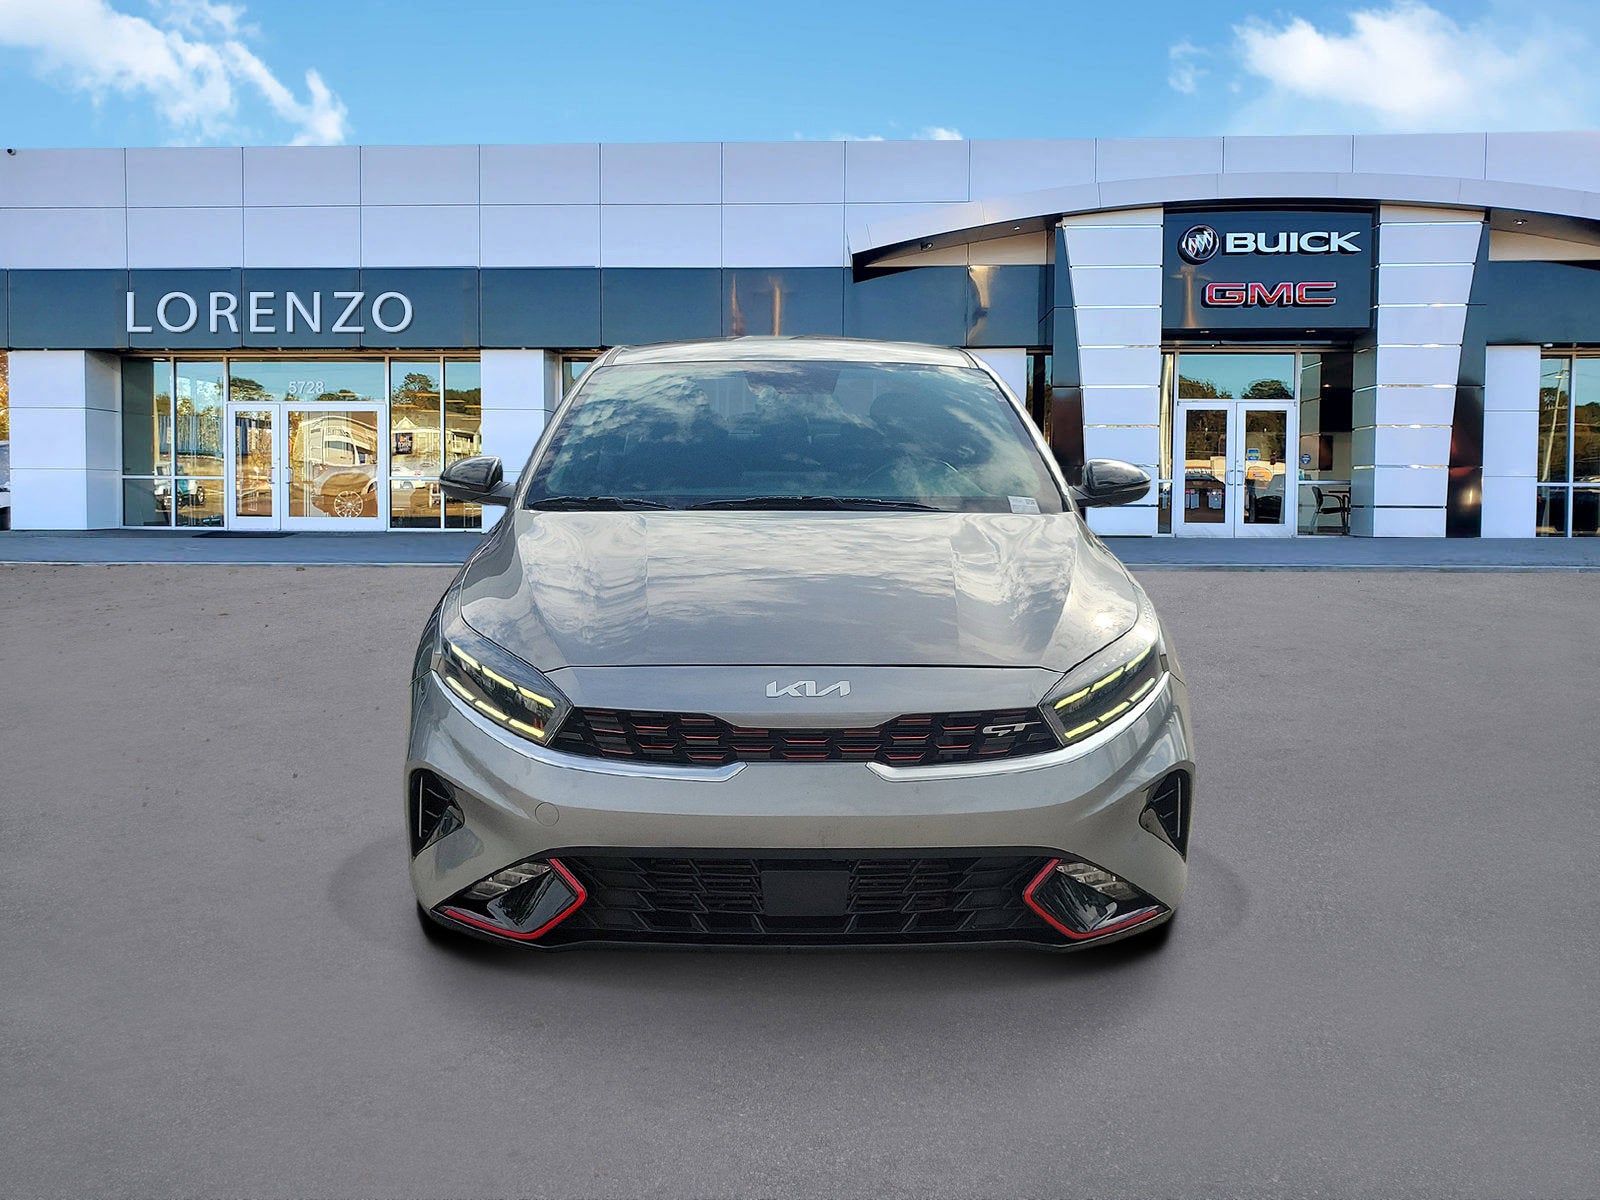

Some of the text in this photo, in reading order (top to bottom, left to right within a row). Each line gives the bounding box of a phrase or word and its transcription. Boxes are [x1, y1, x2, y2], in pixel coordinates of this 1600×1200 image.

[1225, 231, 1362, 253] BUICK
[1205, 282, 1337, 305] GMC
[125, 291, 414, 333] LORENZO
[288, 381, 325, 394] 5728
[766, 680, 851, 697] KIA
[983, 721, 1041, 737] GT
